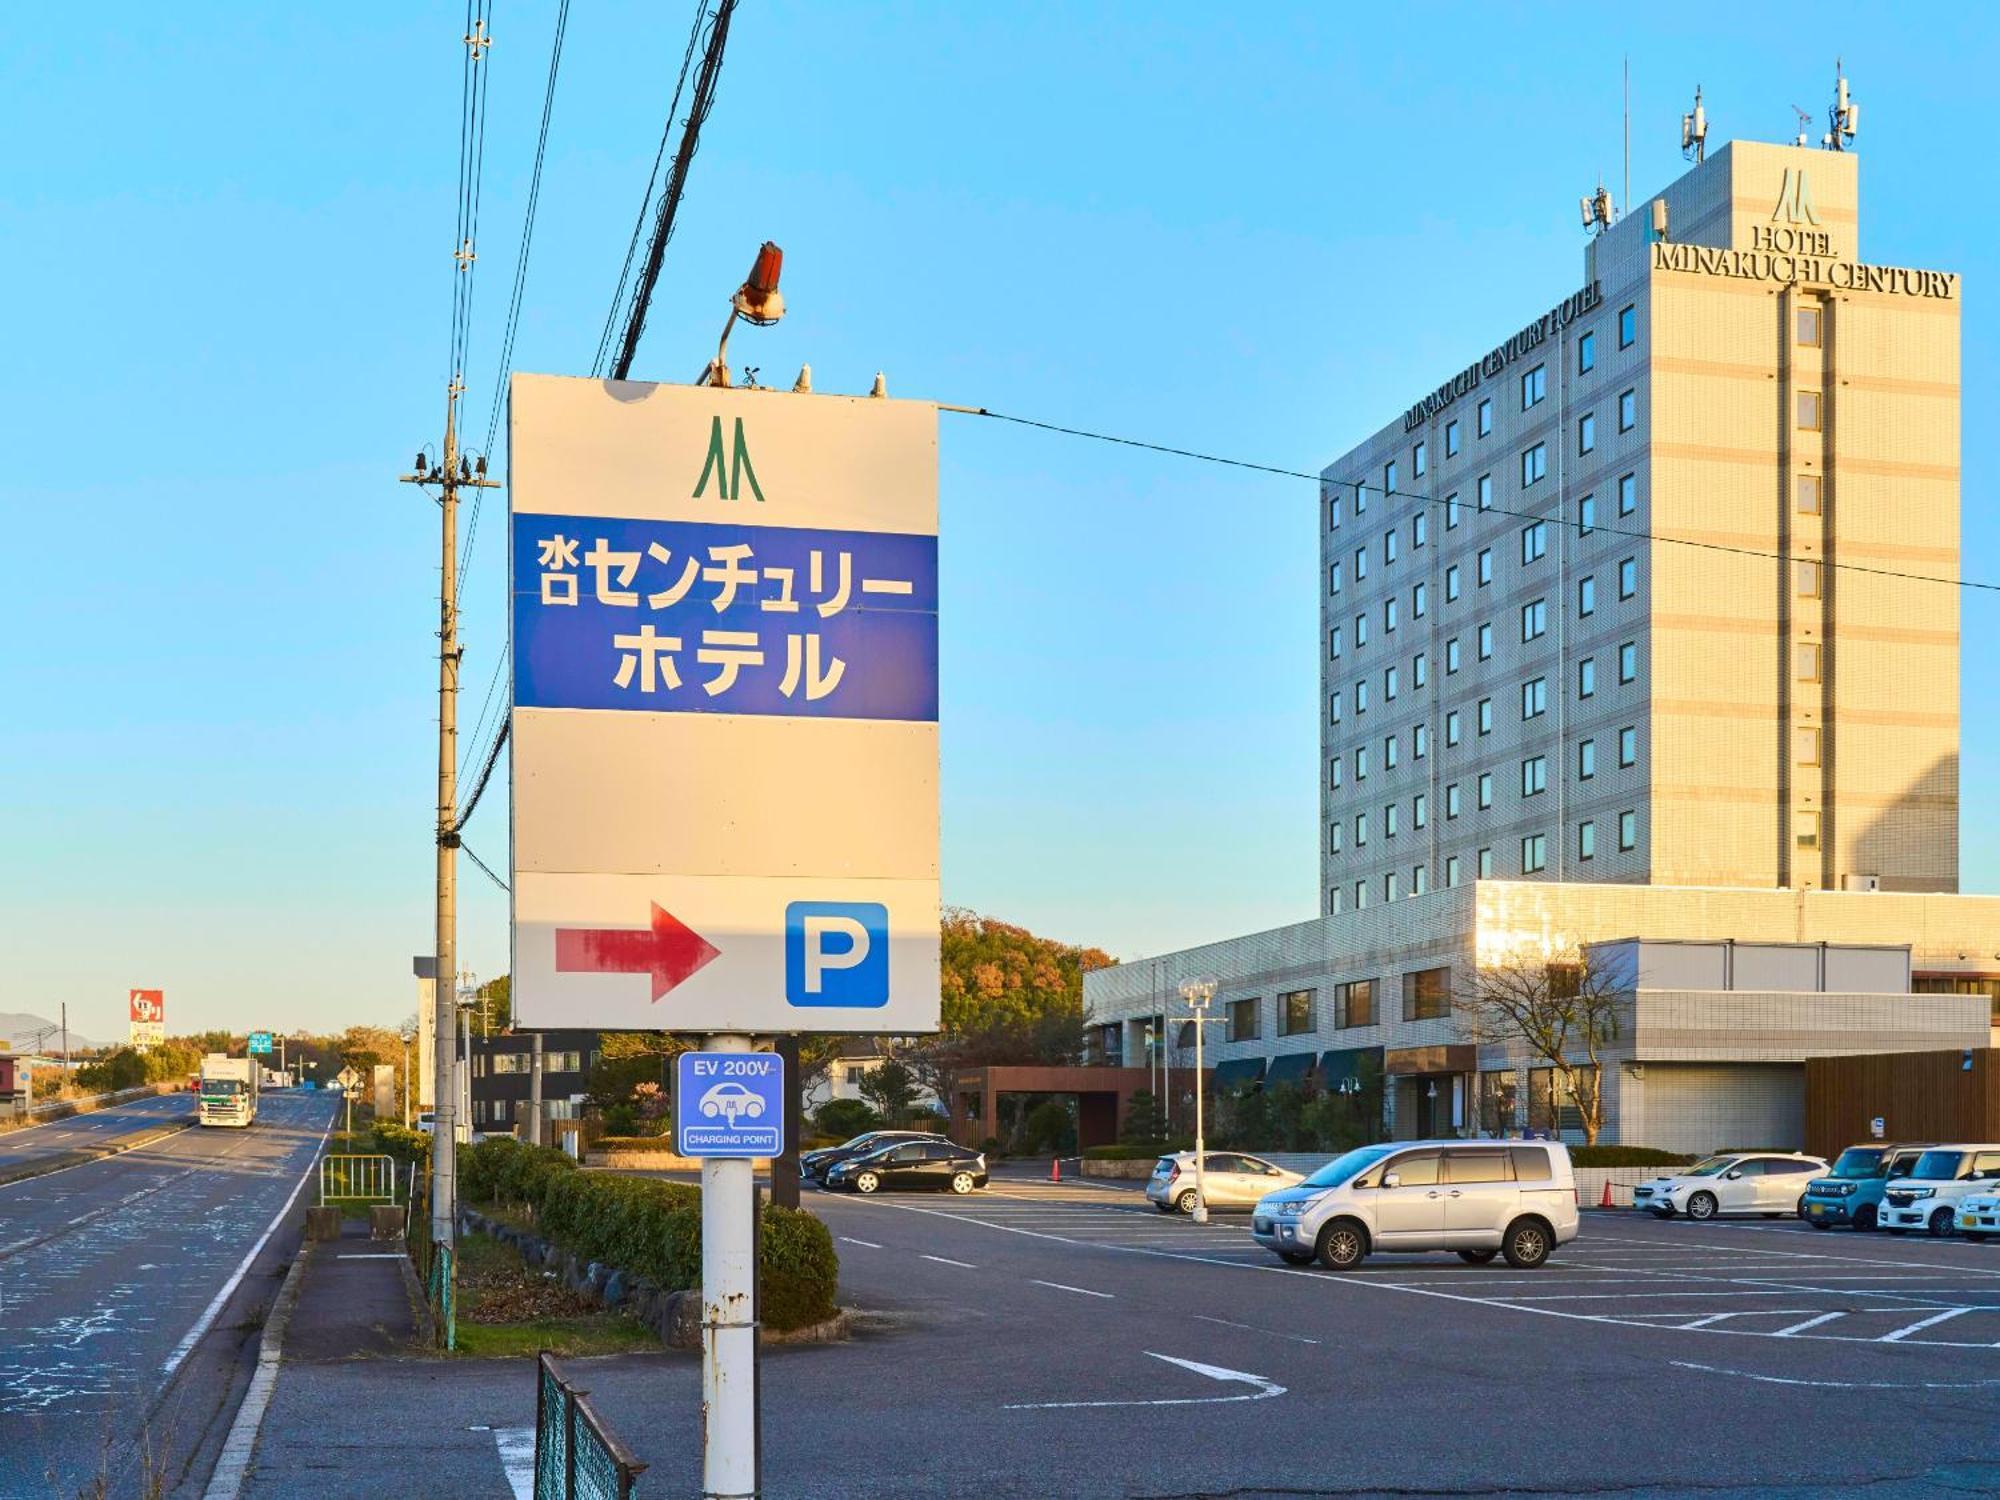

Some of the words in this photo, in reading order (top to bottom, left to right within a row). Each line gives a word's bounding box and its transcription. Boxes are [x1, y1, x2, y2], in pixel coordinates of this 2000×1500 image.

[1752, 225, 1838, 257] HOTEL
[1654, 242, 1824, 283] MINAKUCHI
[1828, 262, 1956, 299] CENTURY
[1404, 362, 1481, 433] MINAKUCHI
[1480, 313, 1550, 380] CENTURY
[1549, 279, 1603, 336] HOTEL
[613, 625, 846, 701] ホテル
[804, 916, 870, 993] P
[694, 1060, 718, 1076] EV
[723, 1060, 770, 1077] 200V
[688, 1134, 740, 1145] CHARGING
[743, 1134, 774, 1145] POINT
